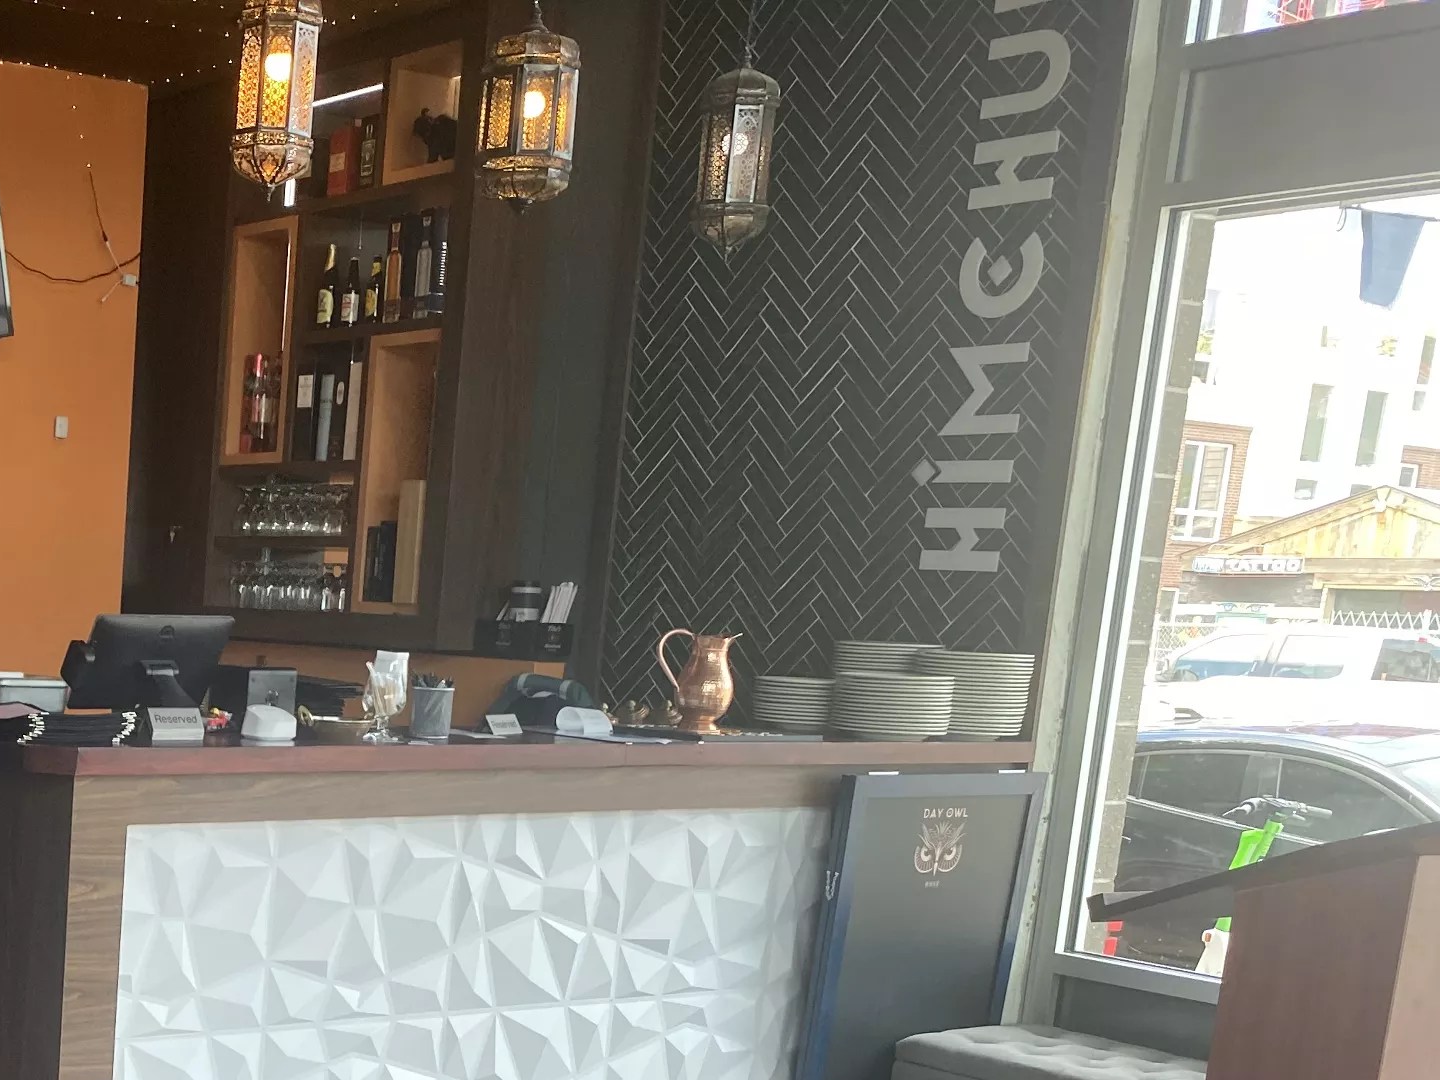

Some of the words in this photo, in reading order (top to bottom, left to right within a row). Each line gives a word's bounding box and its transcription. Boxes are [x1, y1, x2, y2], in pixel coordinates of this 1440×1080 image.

[154, 714, 198, 723] Reserved
[923, 808, 944, 819] DAY
[946, 807, 969, 818] OWL
